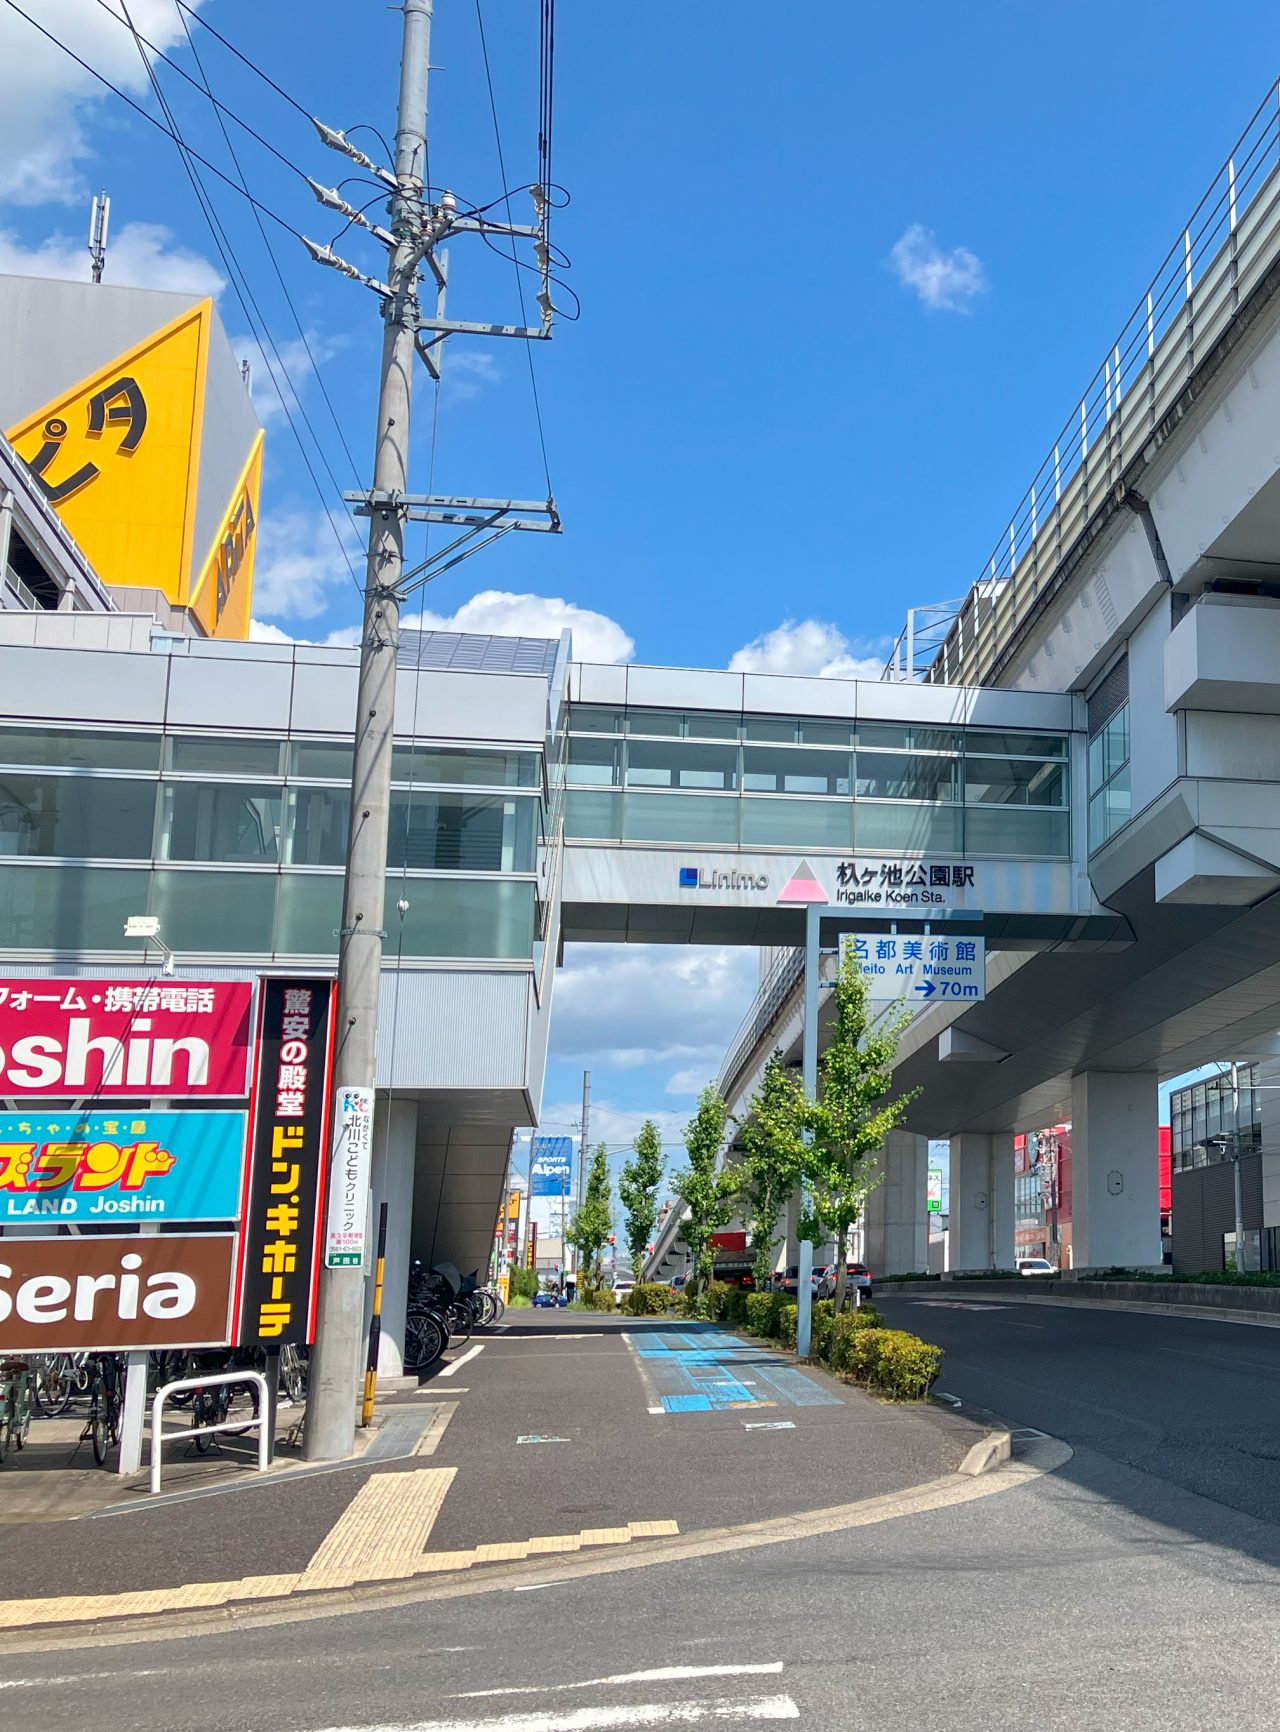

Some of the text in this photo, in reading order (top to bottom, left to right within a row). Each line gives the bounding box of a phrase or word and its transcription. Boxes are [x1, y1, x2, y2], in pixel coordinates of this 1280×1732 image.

[698, 868, 770, 891] Linimo
[836, 888, 946, 904] Irigaike Koen Sta.
[853, 939, 976, 962] 名都美術館
[895, 964, 913, 975] Art
[922, 964, 972, 976] Museum
[940, 982, 978, 996] 70m
[0, 1018, 209, 1088] shin
[258, 988, 312, 1338] 驚安の殿堂 ドン・キホーテ
[343, 1114, 362, 1231] 北川こどもクリニック
[531, 1163, 570, 1177] Alpen
[7, 1195, 165, 1215] LAND Joshin
[0, 1253, 197, 1324] eria
